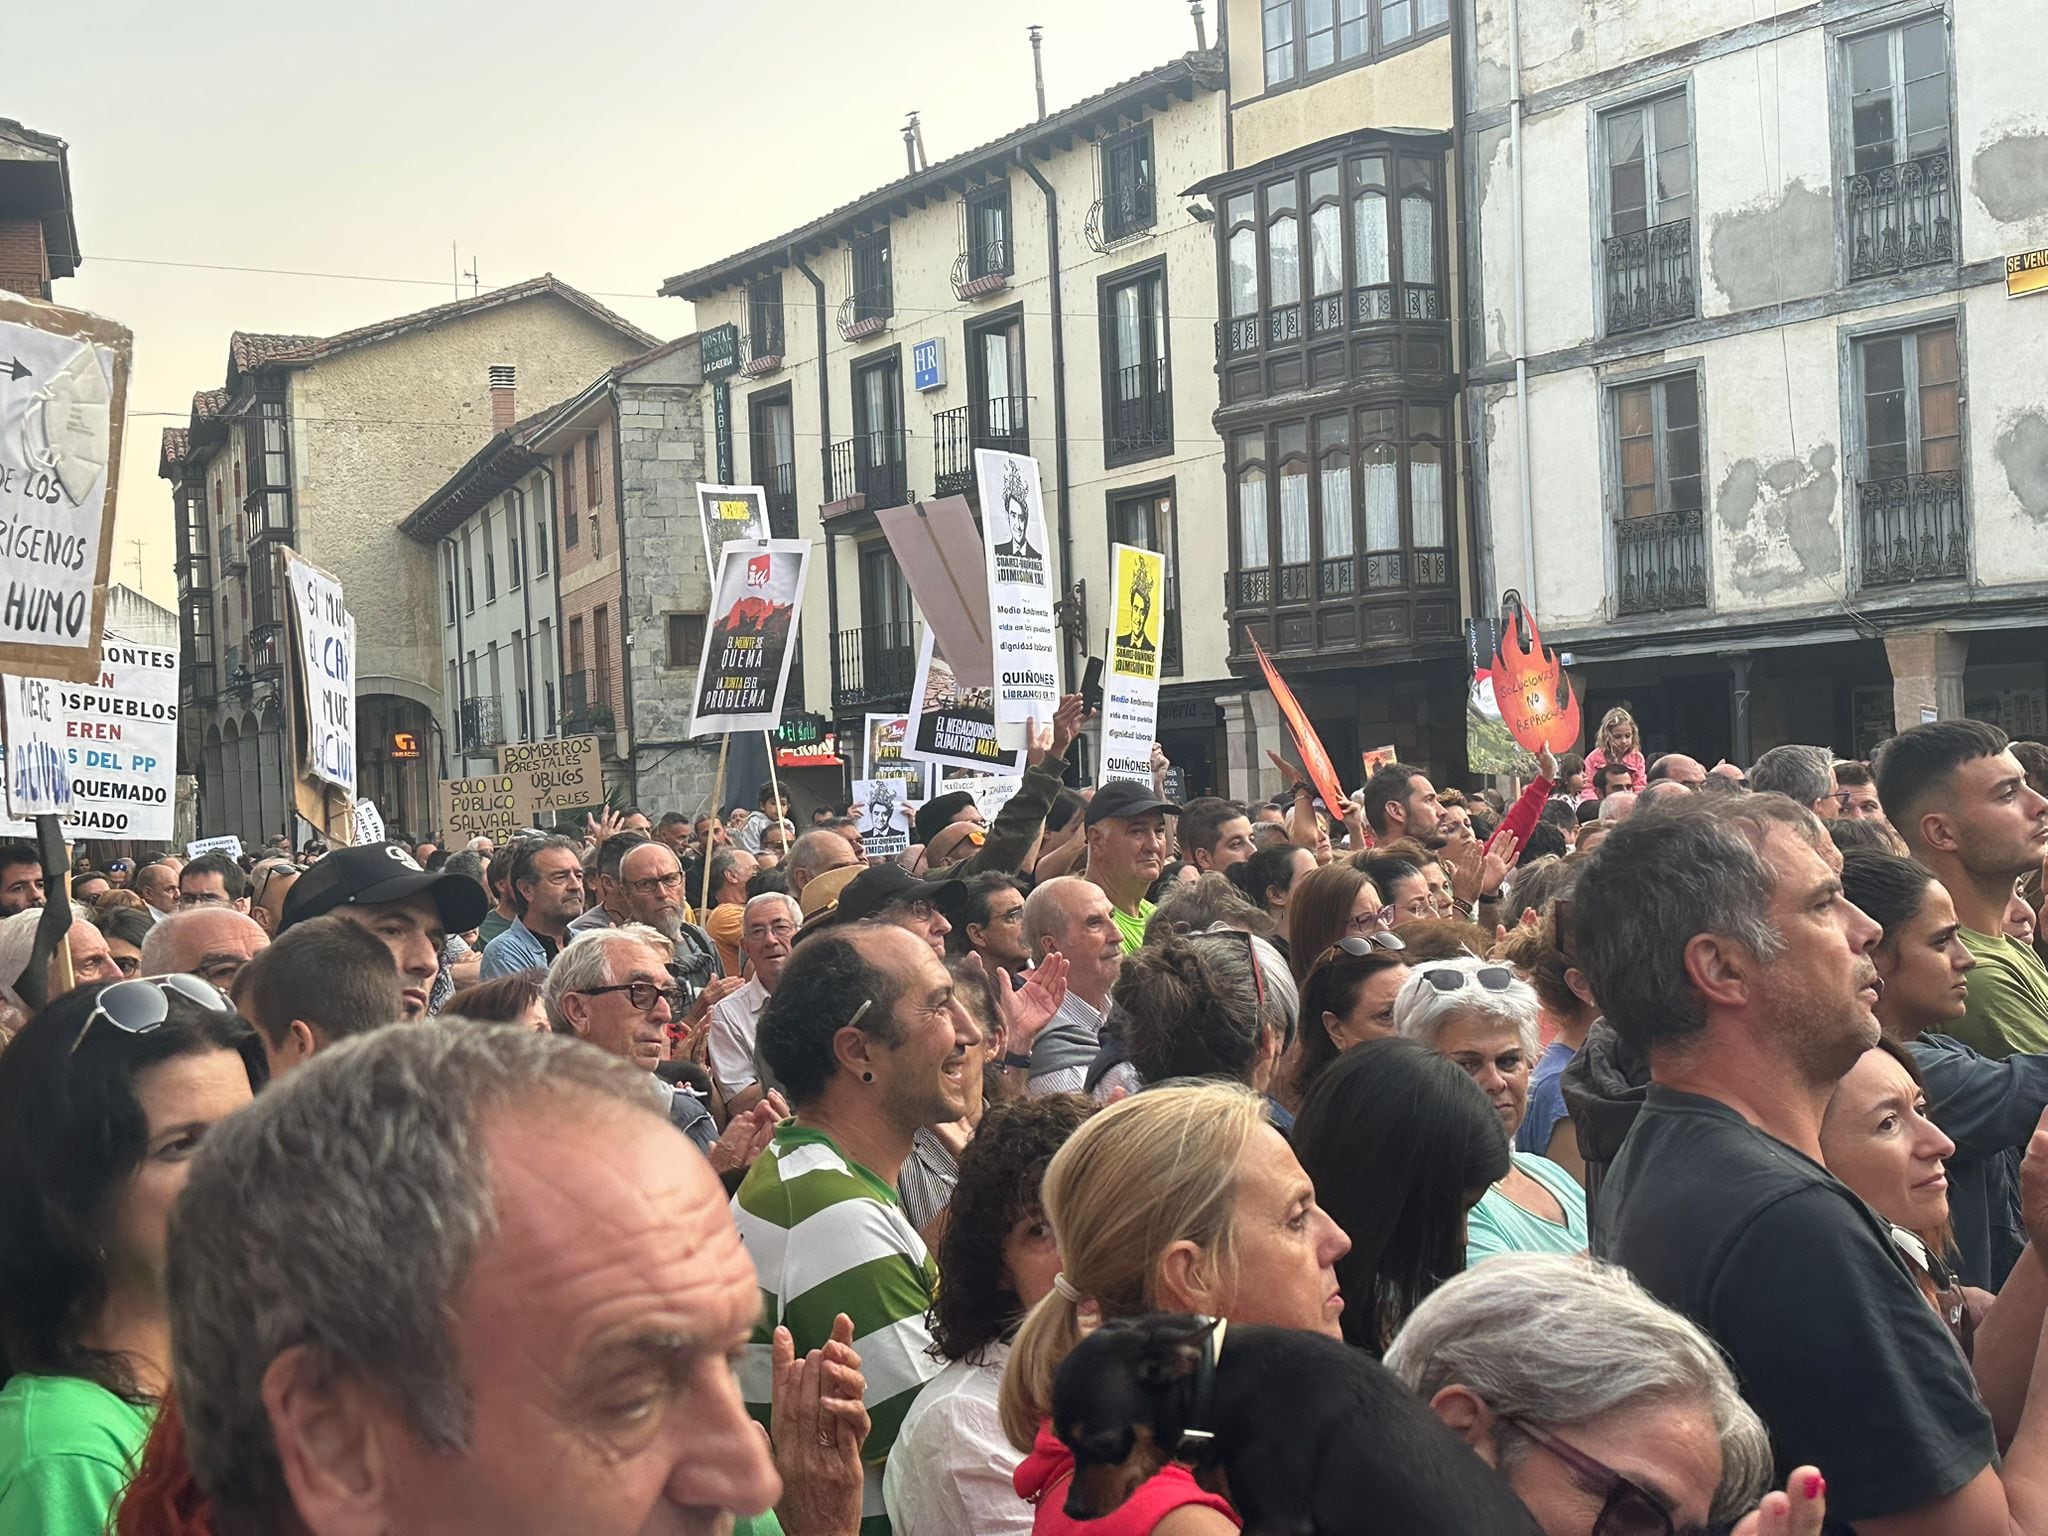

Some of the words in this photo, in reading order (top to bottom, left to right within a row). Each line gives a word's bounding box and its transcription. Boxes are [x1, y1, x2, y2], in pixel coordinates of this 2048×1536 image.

[2008, 256, 2021, 273] SE
[702, 328, 732, 349] HOSTAL
[915, 345, 937, 372] HR
[716, 387, 727, 482] HABITAC
[24, 473, 62, 504] LOS
[5, 581, 86, 638] HUMO
[721, 649, 763, 670] QUEMA
[1002, 669, 1055, 685] QUIÑONES
[1500, 670, 1554, 698] SOLUCIONES
[704, 688, 766, 710] PROBLEMA
[1526, 693, 1540, 709] NO
[936, 716, 945, 732] EL
[1516, 707, 1566, 733] REPROCHES
[66, 721, 122, 741] EREN
[504, 738, 593, 763] BOMBEROS
[976, 739, 999, 758] MATA
[87, 750, 122, 770] DEL
[132, 754, 156, 773] PP
[1107, 757, 1151, 773] QUIÑONES
[493, 777, 513, 793] LO
[531, 768, 584, 788] ÚBLICOS
[72, 779, 167, 803] QUEMADO
[68, 810, 129, 829] SIADO
